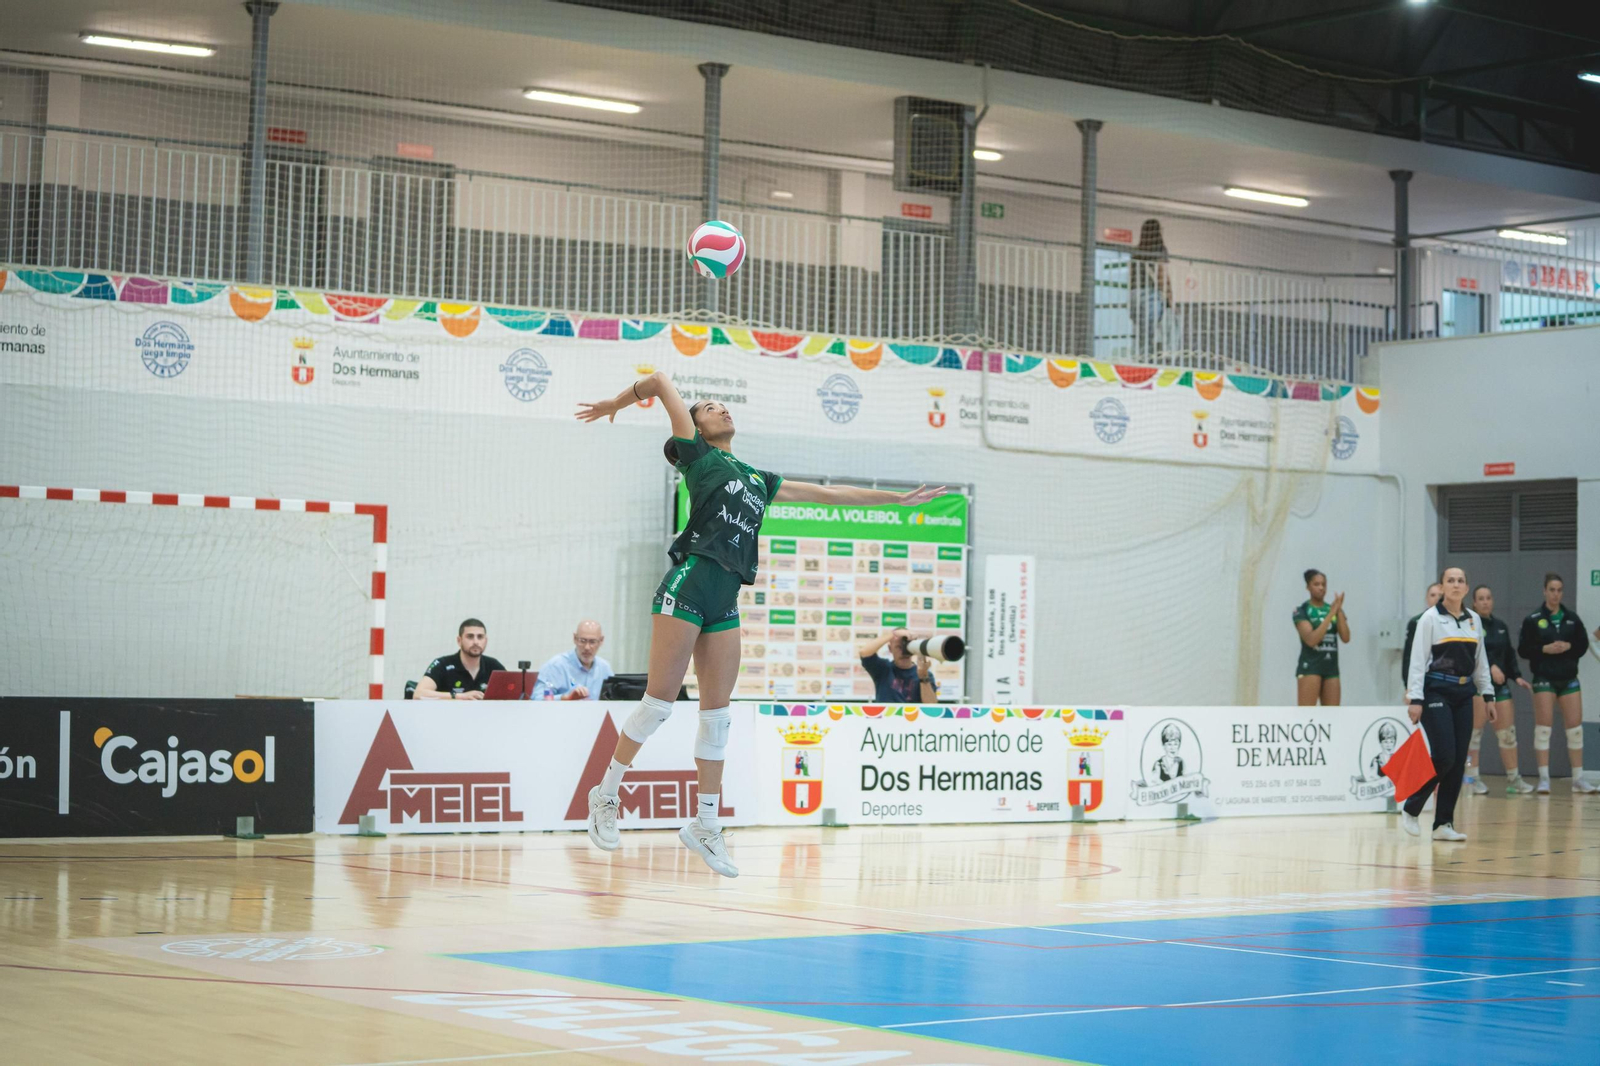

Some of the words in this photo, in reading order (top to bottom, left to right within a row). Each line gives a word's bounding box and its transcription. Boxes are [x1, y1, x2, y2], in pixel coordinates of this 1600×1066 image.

[31, 323, 46, 337] de
[333, 346, 404, 362] Ayuntamiento
[406, 352, 420, 363] de
[333, 362, 356, 375] Dos
[360, 364, 419, 379] Hermanas
[769, 505, 841, 522] IBERDROLA
[842, 509, 903, 525] VOLEIBOL
[998, 592, 1006, 637] Hermanas
[1008, 605, 1017, 643] (Sevilla)
[998, 640, 1006, 656] Dos
[860, 726, 1010, 758] Ayuntamiento
[1016, 728, 1043, 753] de
[1231, 724, 1255, 743] EL
[1258, 719, 1332, 744] RINCÓN
[101, 735, 275, 798] Cajasol
[1236, 748, 1262, 767] DE
[1266, 743, 1326, 767] MARÍA
[861, 765, 910, 791] Dos
[918, 765, 1043, 791] Hermanas
[861, 801, 922, 819] Deportes
